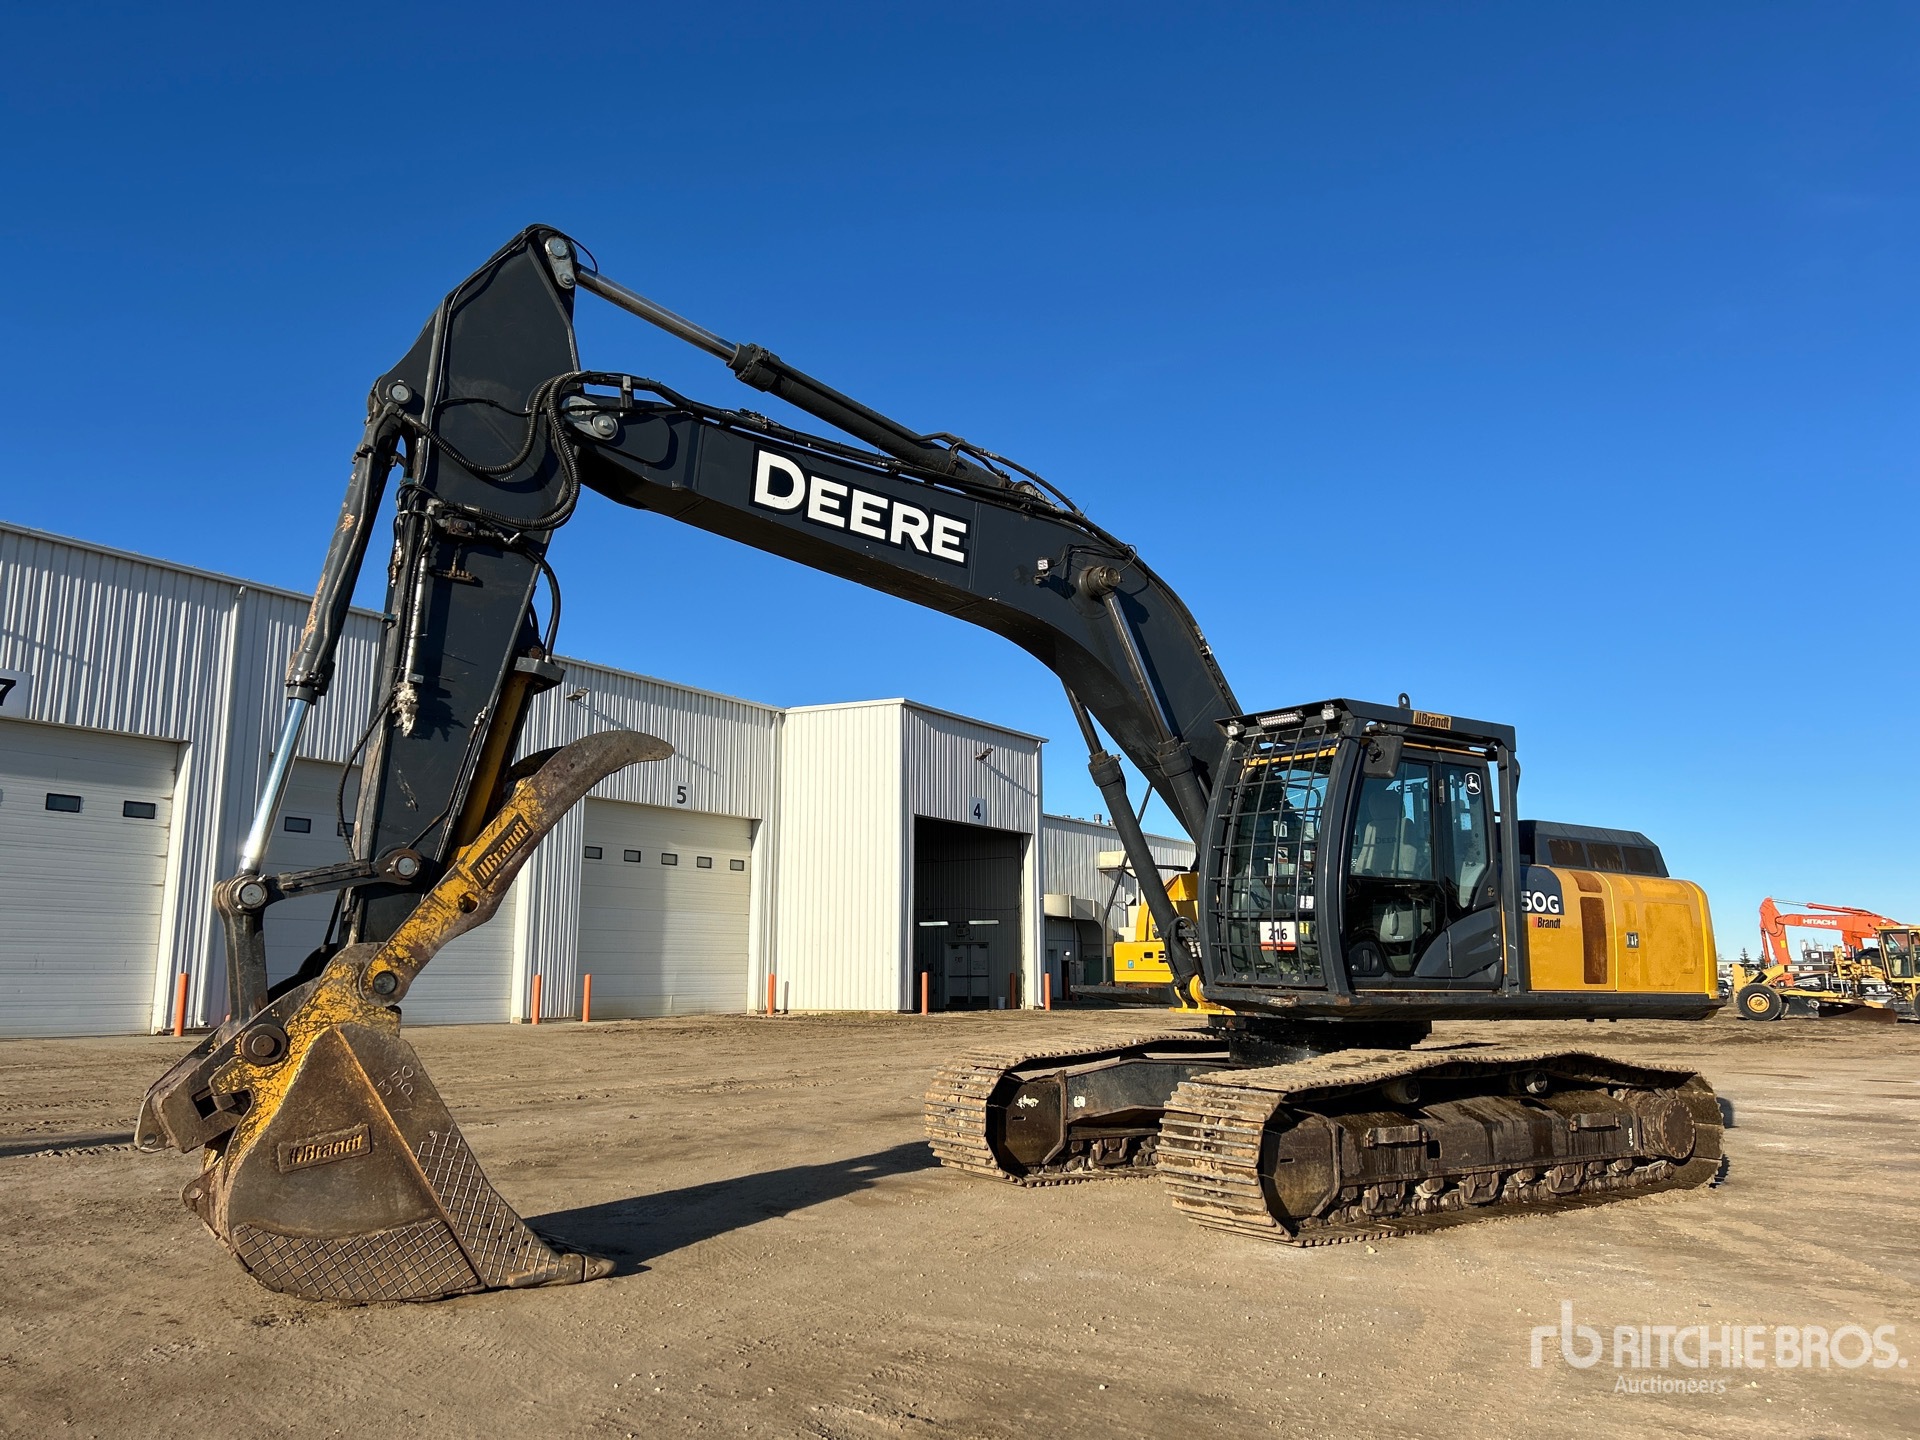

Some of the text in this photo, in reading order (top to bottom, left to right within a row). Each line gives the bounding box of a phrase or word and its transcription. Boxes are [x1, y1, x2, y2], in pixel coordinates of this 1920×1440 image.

[754, 450, 966, 563] DEERE
[1420, 712, 1450, 729] Brandt
[676, 785, 687, 804] 5
[973, 803, 982, 820] 4
[481, 821, 529, 875] Brandt
[1536, 917, 1561, 929] Brandt
[1802, 918, 1838, 926] HITACHI
[1268, 928, 1288, 940] 216
[300, 1134, 363, 1163] Brandt
